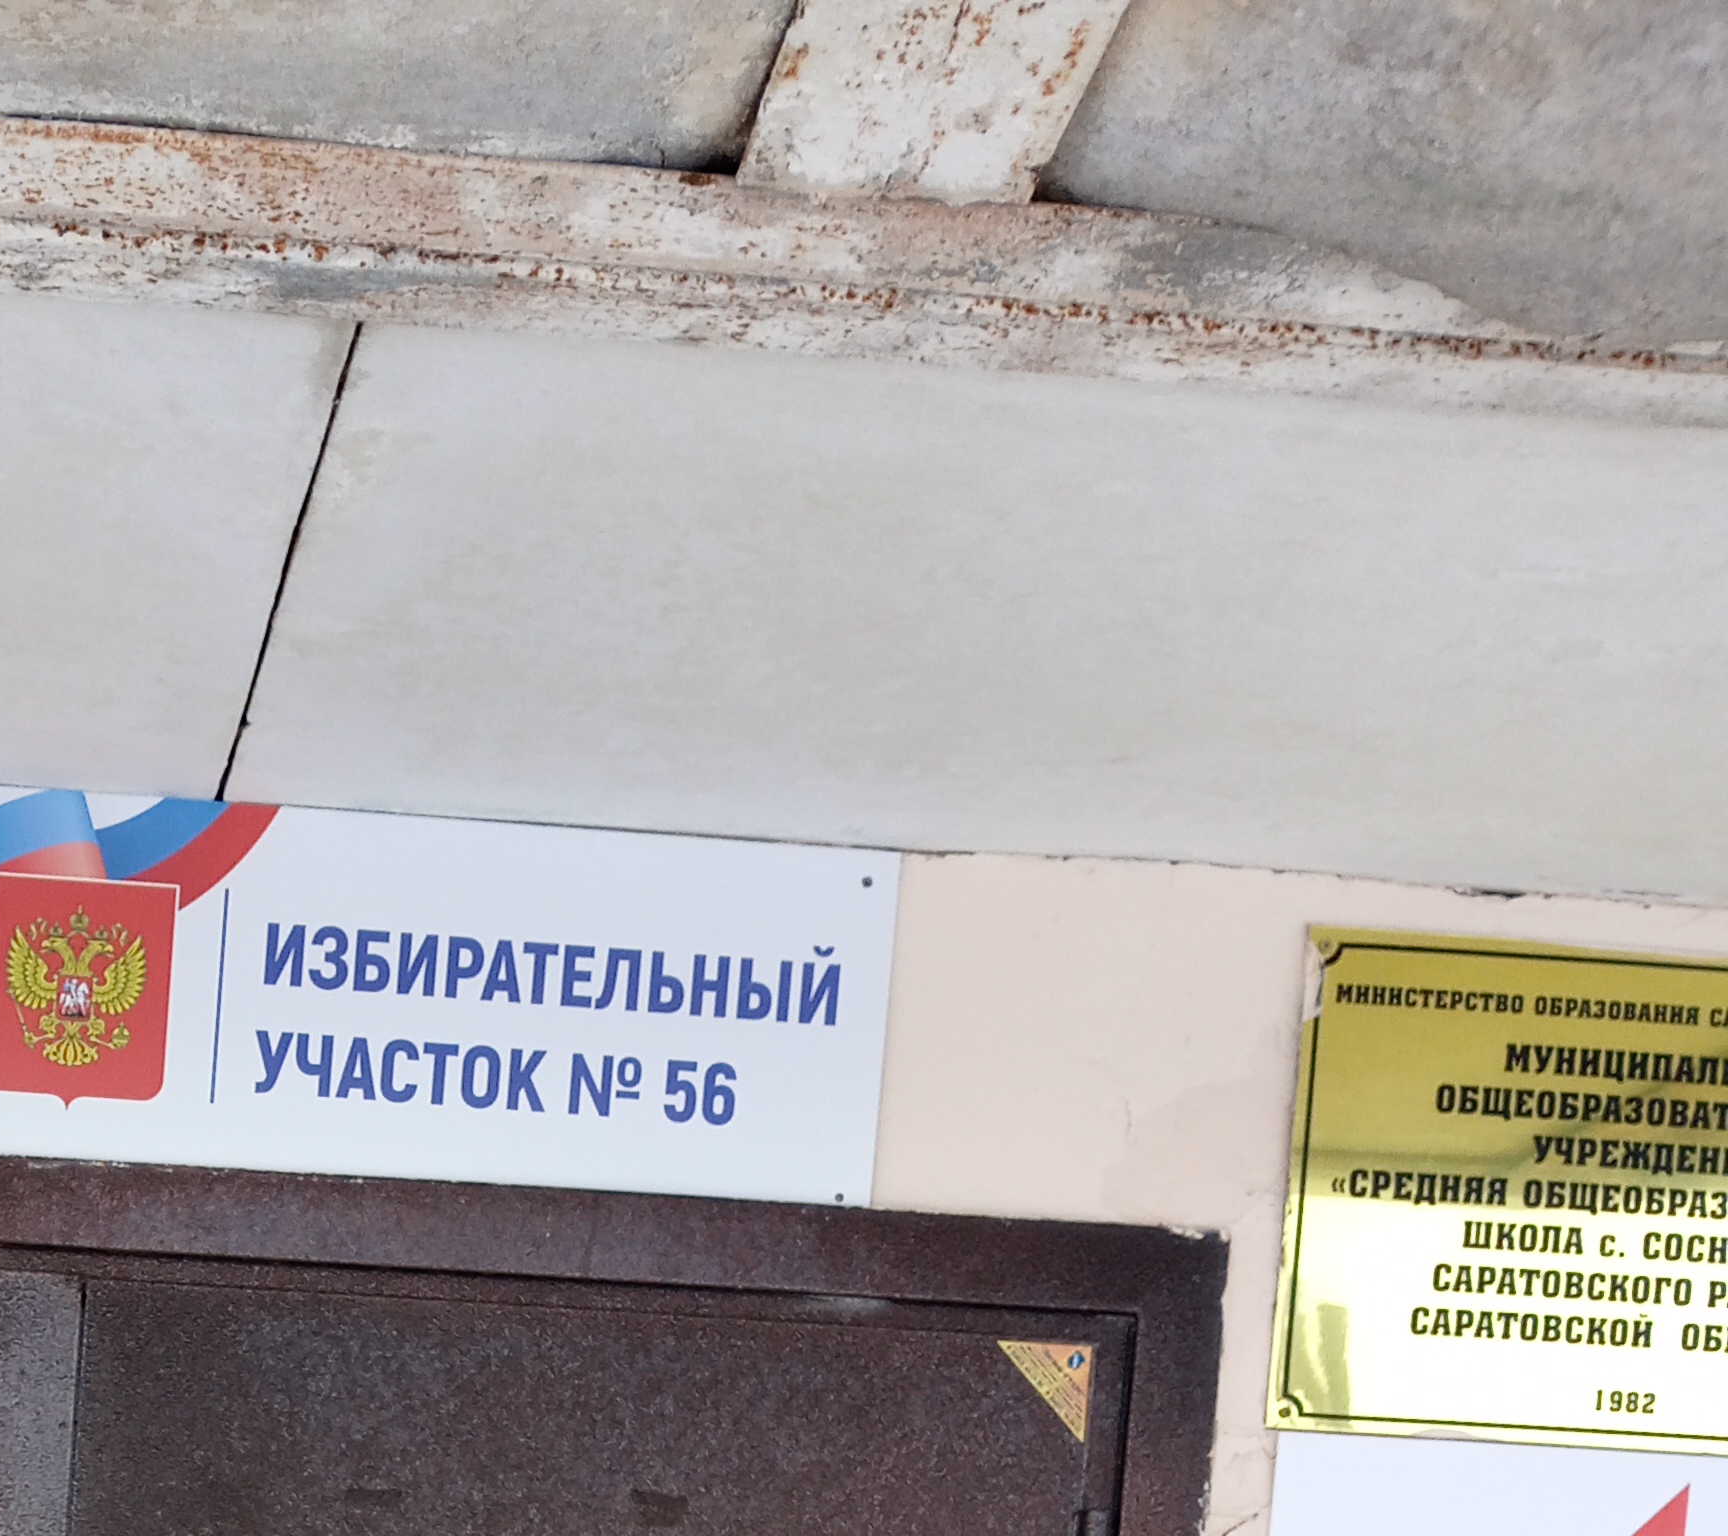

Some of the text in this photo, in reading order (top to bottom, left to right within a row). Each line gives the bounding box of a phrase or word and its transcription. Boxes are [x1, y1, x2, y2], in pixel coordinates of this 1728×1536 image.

[263, 923, 842, 1026] ИЗБИРАТЕЛЬНЫЙ
[1336, 983, 1523, 1015] МИНИСТЕРСТВО
[1535, 996, 1699, 1026] ОБРАЗОВАНИЯ
[255, 1029, 736, 1126] УЧАСТОК № 56
[1436, 1084, 1728, 1131] ОБЩЕОБРАЗОВАТ
[1533, 1135, 1728, 1177] УЧРЕЖДЕН
[1332, 1169, 1728, 1219] «СРЕДНЯЯ ОБЩЕОБРАЗ
[1462, 1220, 1728, 1264] ШКОЛА с. СОСН
[1432, 1263, 1728, 1309] САРАТОВСКОГО Р
[1410, 1307, 1728, 1353] САРАТОВСКОЙ ОБ
[1595, 1390, 1656, 1414] 1982
